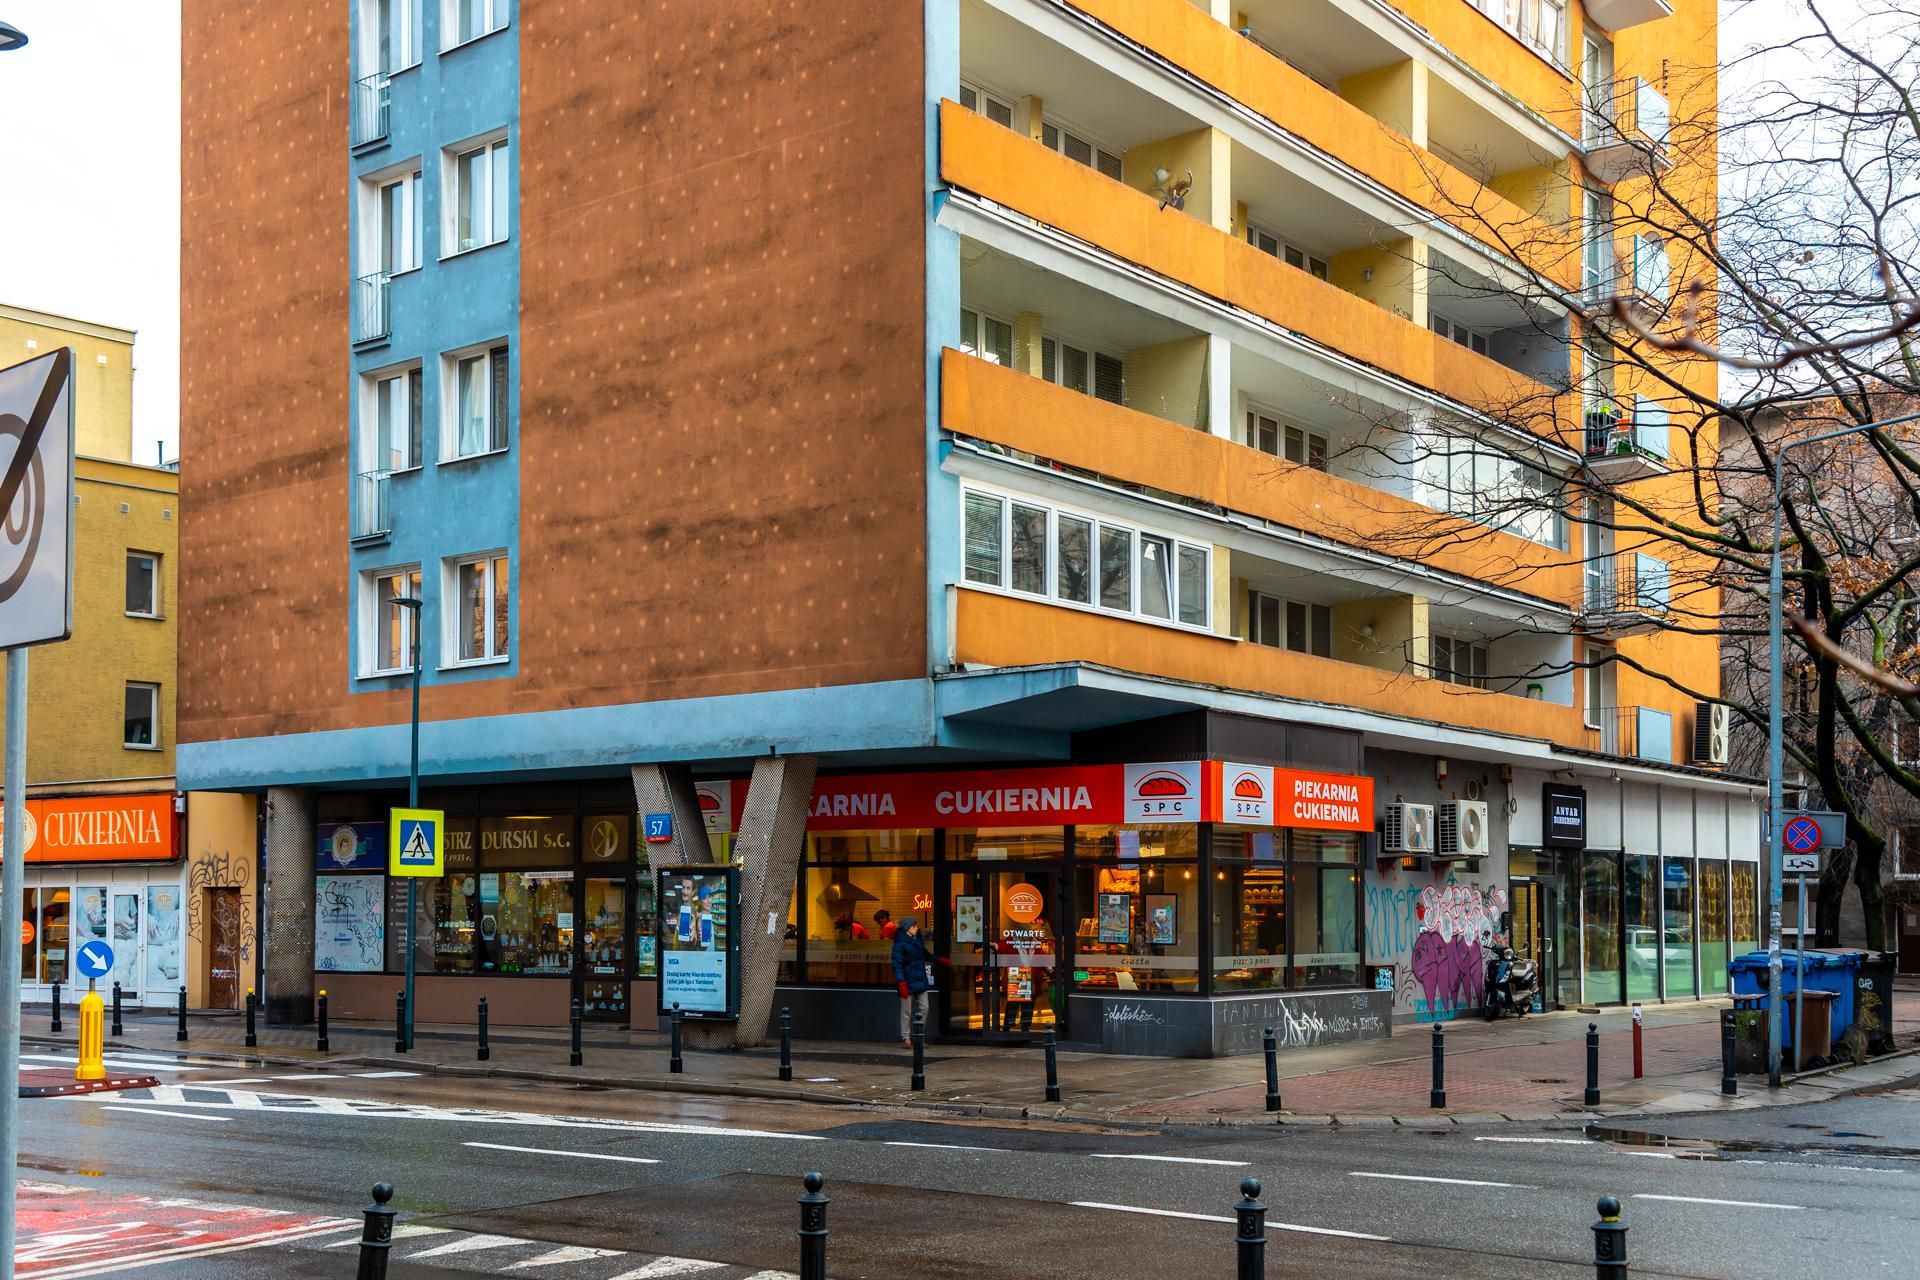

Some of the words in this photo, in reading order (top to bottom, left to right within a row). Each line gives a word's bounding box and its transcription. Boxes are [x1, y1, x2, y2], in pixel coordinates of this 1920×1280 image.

[935, 785, 1093, 815] CUKIERNIA
[1294, 779, 1359, 803] PIEKARNIA
[806, 793, 897, 817] ARNIA
[1294, 801, 1360, 823] CUKIERNIA
[1555, 806, 1578, 816] ANVAR
[44, 809, 162, 847] CUKIERNIA
[651, 820, 663, 835] 57
[482, 830, 539, 850] DURSKI
[543, 832, 571, 848] s.c.
[913, 894, 932, 910] Soki
[1003, 929, 1045, 938] OTWARTE
[1121, 957, 1150, 965] ciasta
